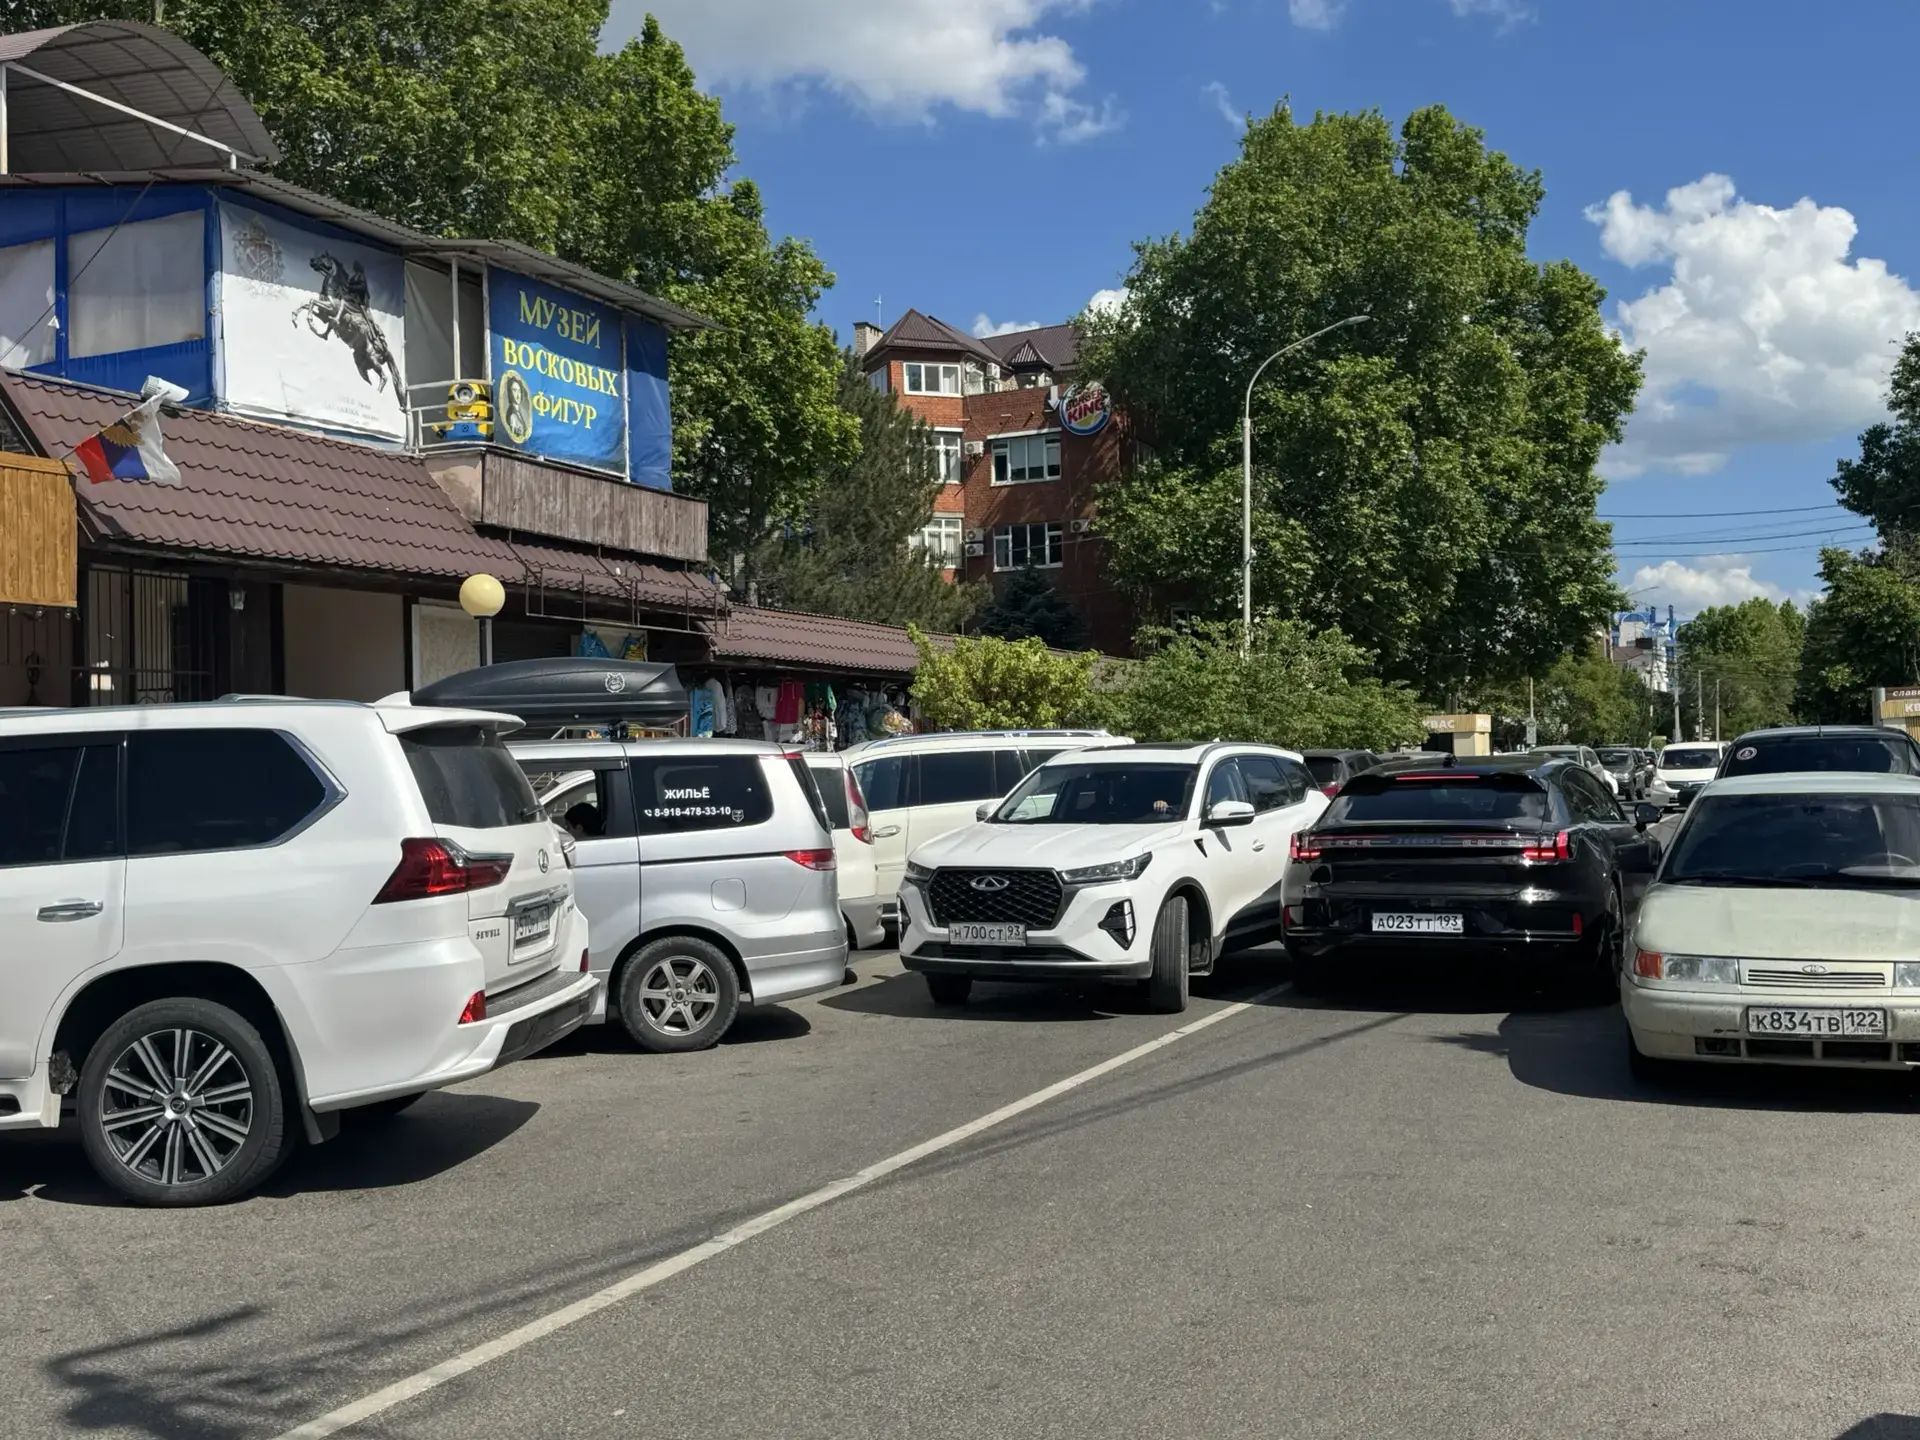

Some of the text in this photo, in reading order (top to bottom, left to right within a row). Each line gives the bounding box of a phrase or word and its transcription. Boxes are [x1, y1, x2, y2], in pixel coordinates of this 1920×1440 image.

[519, 290, 602, 350] МУЗЕЙ
[503, 337, 620, 398] ВОСКОВЫХ
[532, 391, 598, 430] ФИГУР
[1066, 398, 1105, 425] KING
[664, 786, 711, 800] ЖИЛЬЁ
[654, 806, 732, 818] 8-918-478-33-10
[1845, 1011, 1879, 1028] 122
